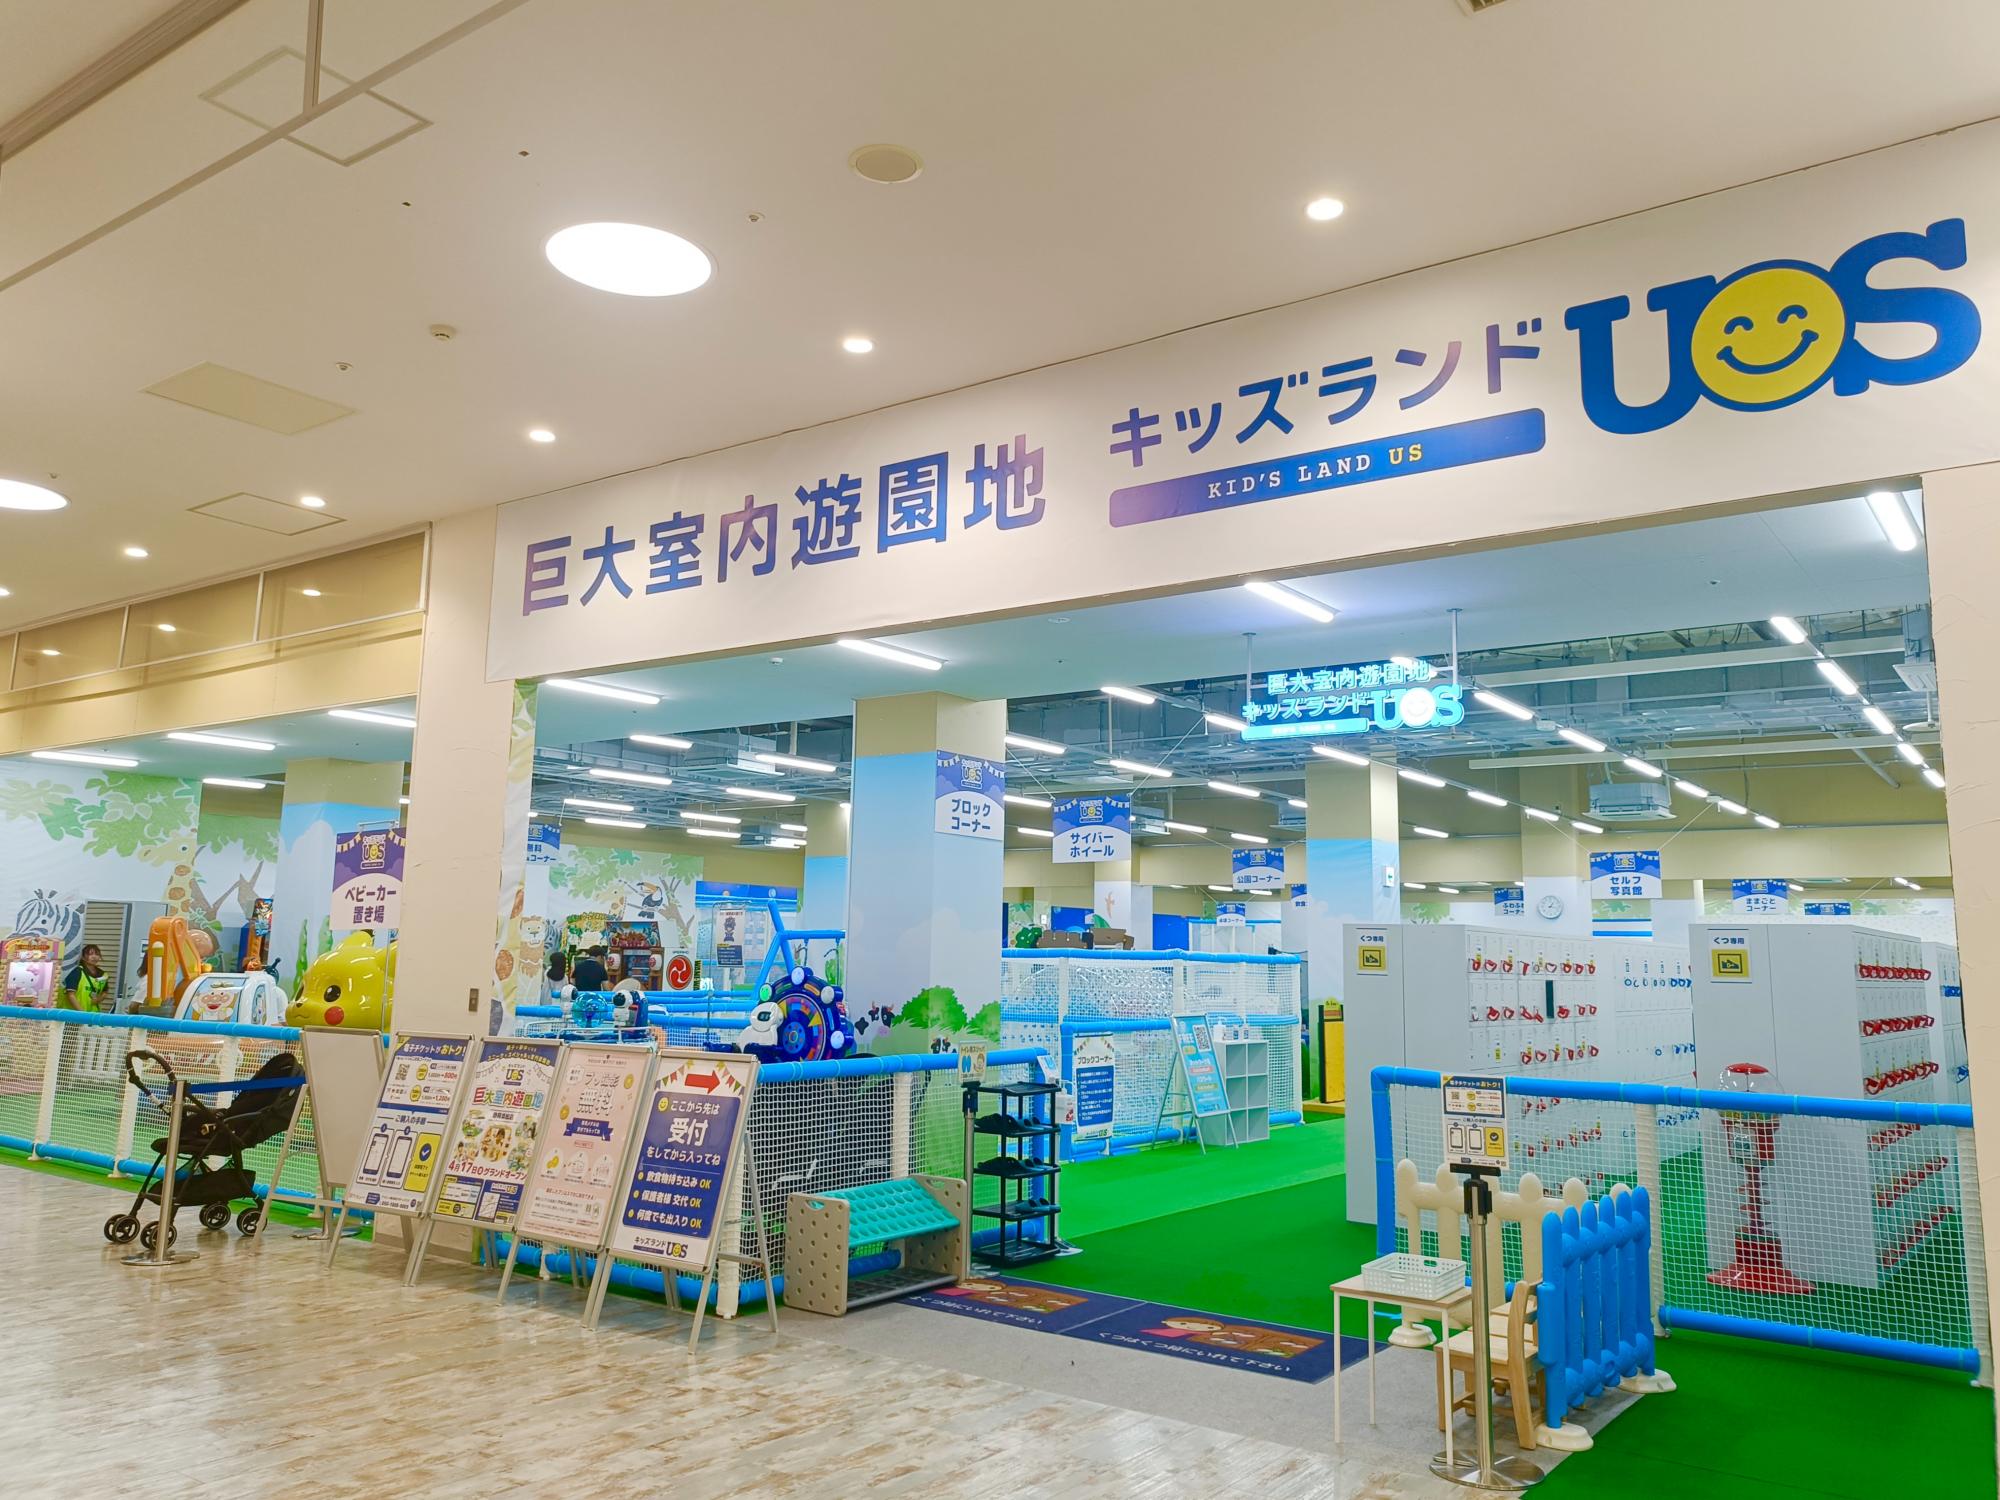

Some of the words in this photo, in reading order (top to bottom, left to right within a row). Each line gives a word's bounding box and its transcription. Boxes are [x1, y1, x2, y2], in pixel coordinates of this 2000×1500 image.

[1110, 318, 1542, 467] キッズランド
[1207, 470, 1282, 500] KID'S
[1297, 453, 1372, 483] LAND
[1388, 443, 1424, 465] US
[522, 434, 1046, 616] 巨大室内遊園地
[1267, 660, 1431, 695] 巨大室内遊園地
[1241, 693, 1369, 722] キッズランド
[951, 799, 991, 817] ブロック
[951, 816, 991, 832] コーナー
[1070, 832, 1114, 844] サイバー
[1070, 845, 1114, 858] ホイール
[1236, 875, 1281, 884] 公園コーナー
[1609, 876, 1642, 885] セルフ
[345, 884, 397, 903] ベビーカー
[1609, 886, 1643, 896] 写真館
[353, 905, 385, 924] 置き場
[1713, 937, 1744, 945] くつ専用
[1077, 1056, 1113, 1065] ブロックコーナー
[473, 1087, 544, 1108] 巨大室内遊園地
[671, 1100, 720, 1115] ここから先は
[667, 1117, 708, 1147] 受付
[646, 1146, 721, 1166] をしてから入ってね
[646, 1170, 698, 1188] 飲食物持ち込み
[700, 1179, 712, 1189] OK
[641, 1190, 672, 1205] 保護者様
[672, 1194, 689, 1208] 交代
[689, 1198, 702, 1208] OK
[637, 1209, 689, 1227] 何度でも出入り
[690, 1218, 703, 1229] OK
[634, 1236, 667, 1247] キッズランド
